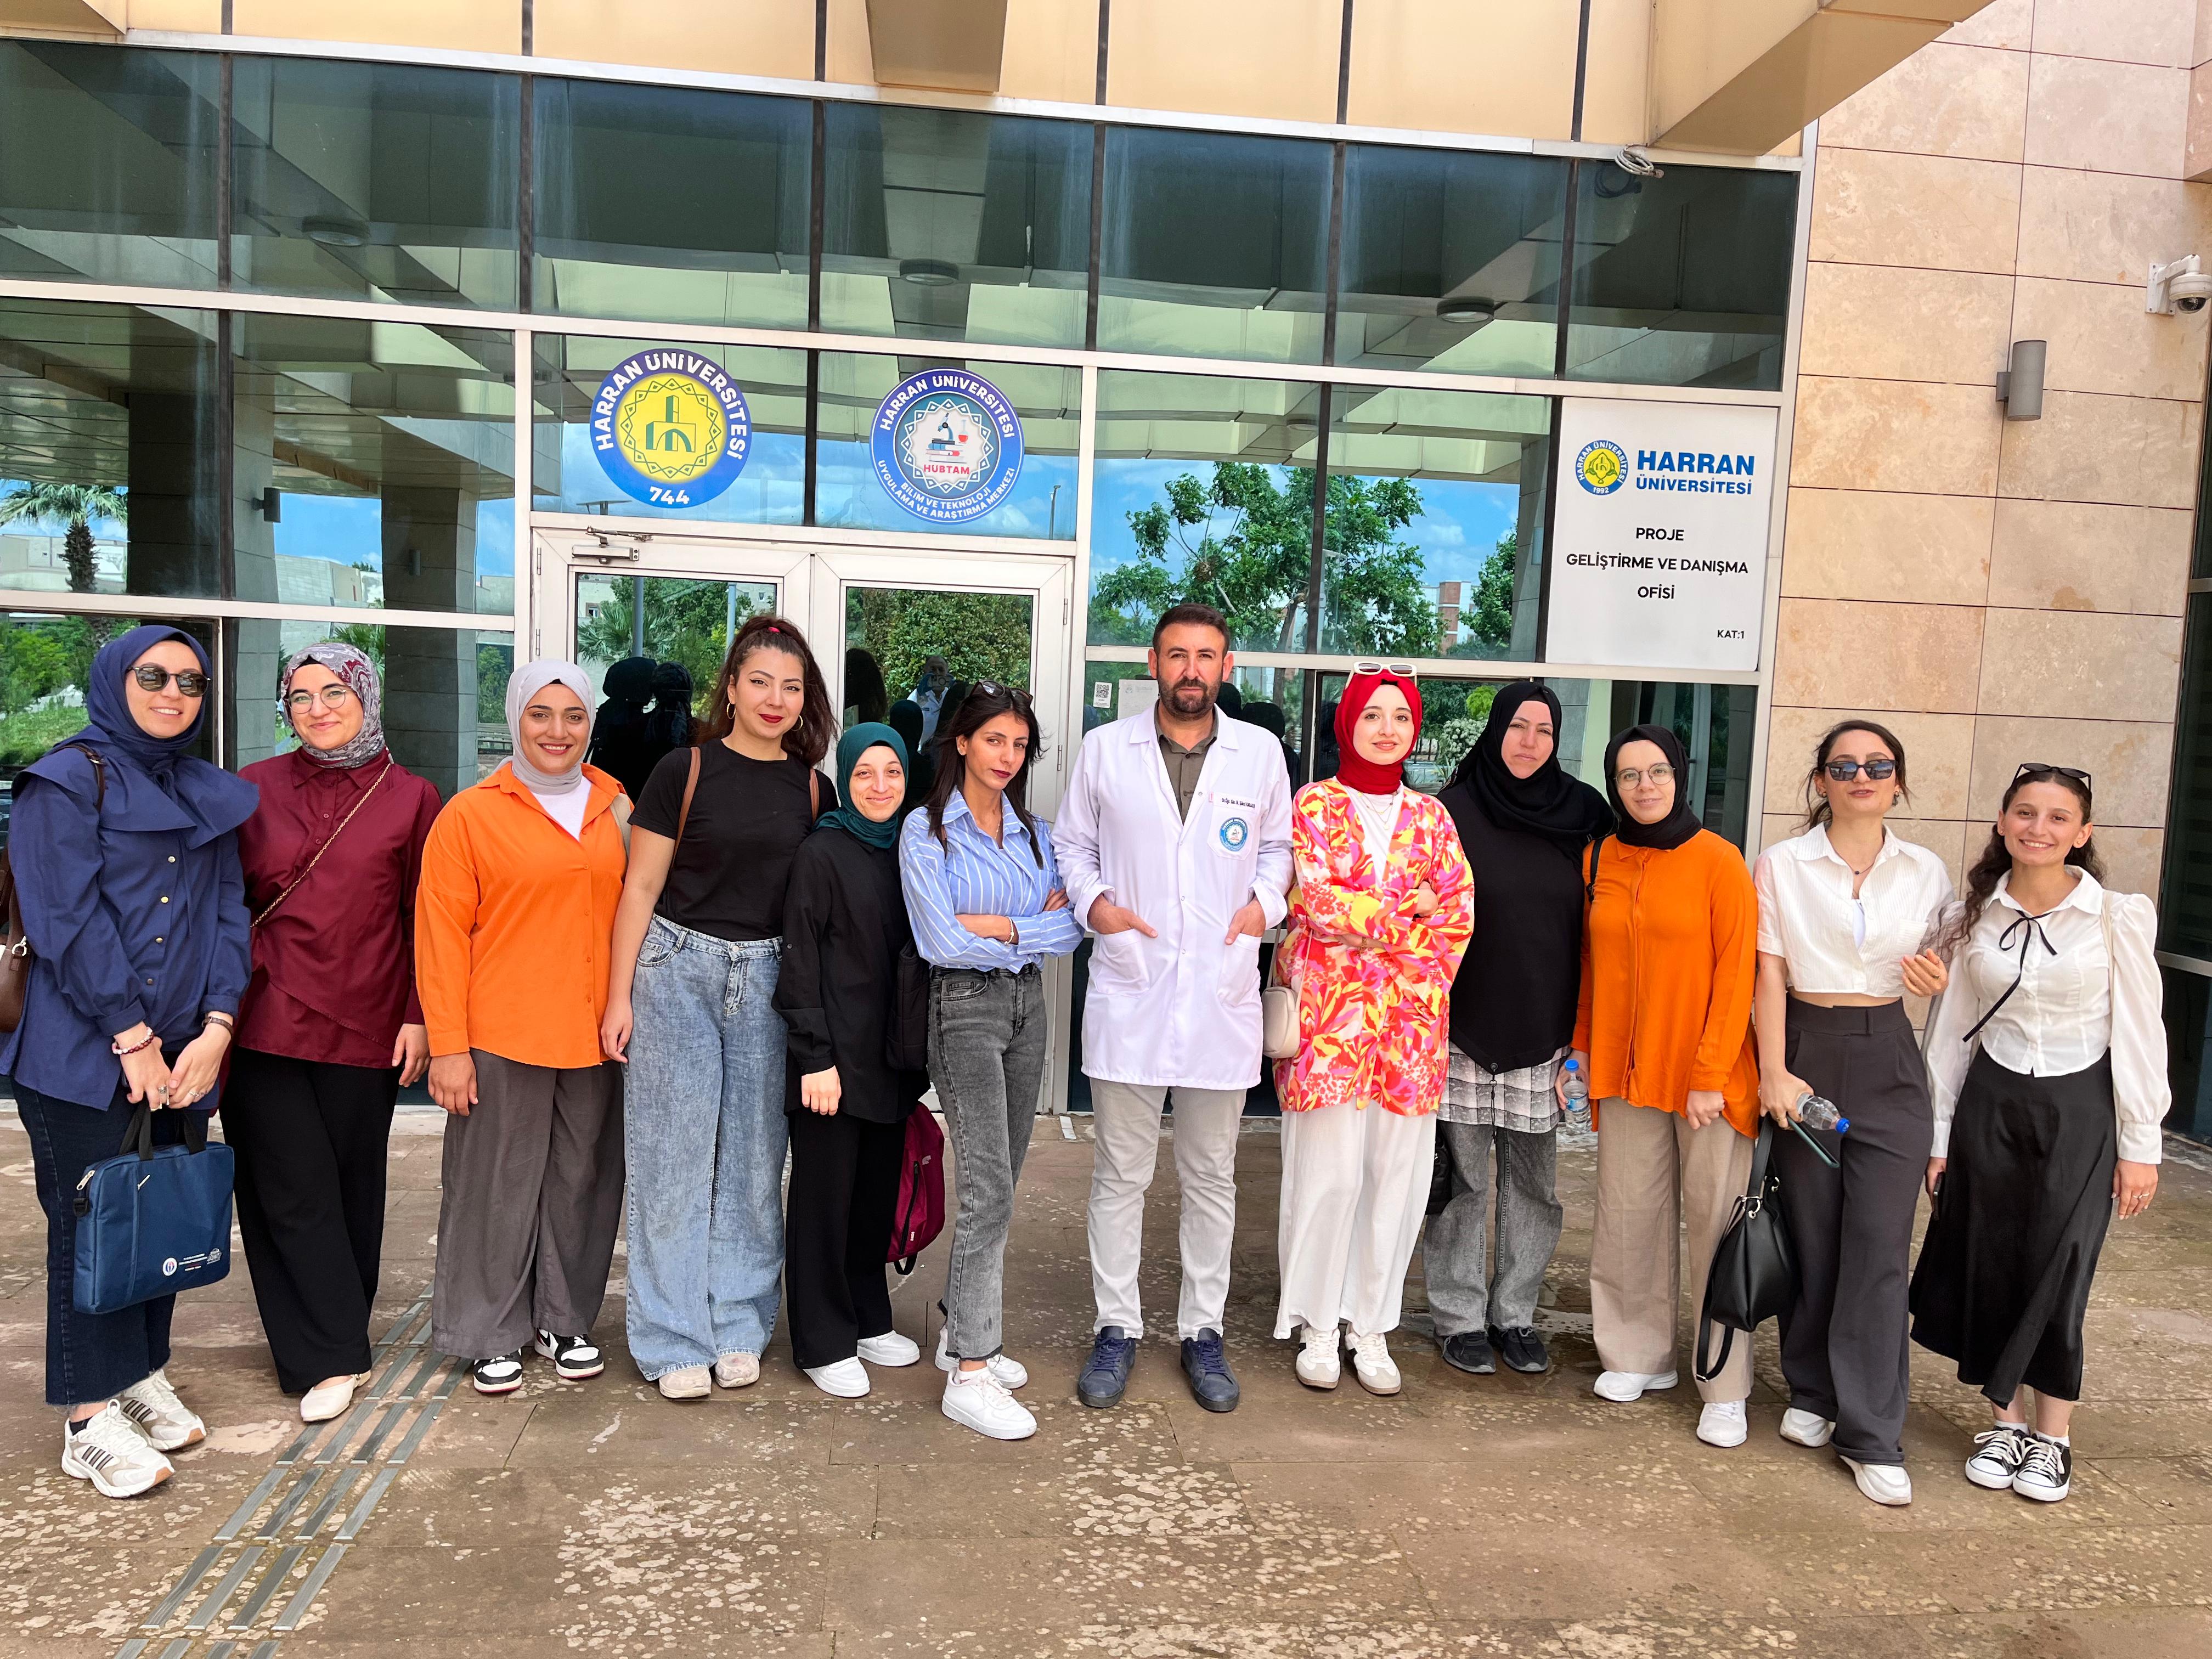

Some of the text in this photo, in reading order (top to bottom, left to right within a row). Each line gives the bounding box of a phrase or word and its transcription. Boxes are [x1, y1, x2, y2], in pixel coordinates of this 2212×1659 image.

[594, 360, 644, 450] HARRAN
[879, 379, 928, 431] HARRAN
[923, 464, 970, 475] HUBTAM
[1577, 445, 1593, 481] HARRAN
[1637, 450, 1755, 476] HARRAN
[878, 460, 915, 509] UYGULAMA
[917, 503, 929, 515] VE
[929, 501, 988, 519] ARAŞTIRMA
[1636, 473, 1752, 495] ÜNİVERSİTESİ
[649, 486, 690, 505] 744
[926, 498, 939, 508] VE
[1635, 527, 1684, 541] PROJE
[1566, 551, 1748, 575] GELİŞTİRME VE DANIŞMA
[1638, 584, 1675, 599] OFİSİ
[1717, 629, 1745, 639] KAT:1
